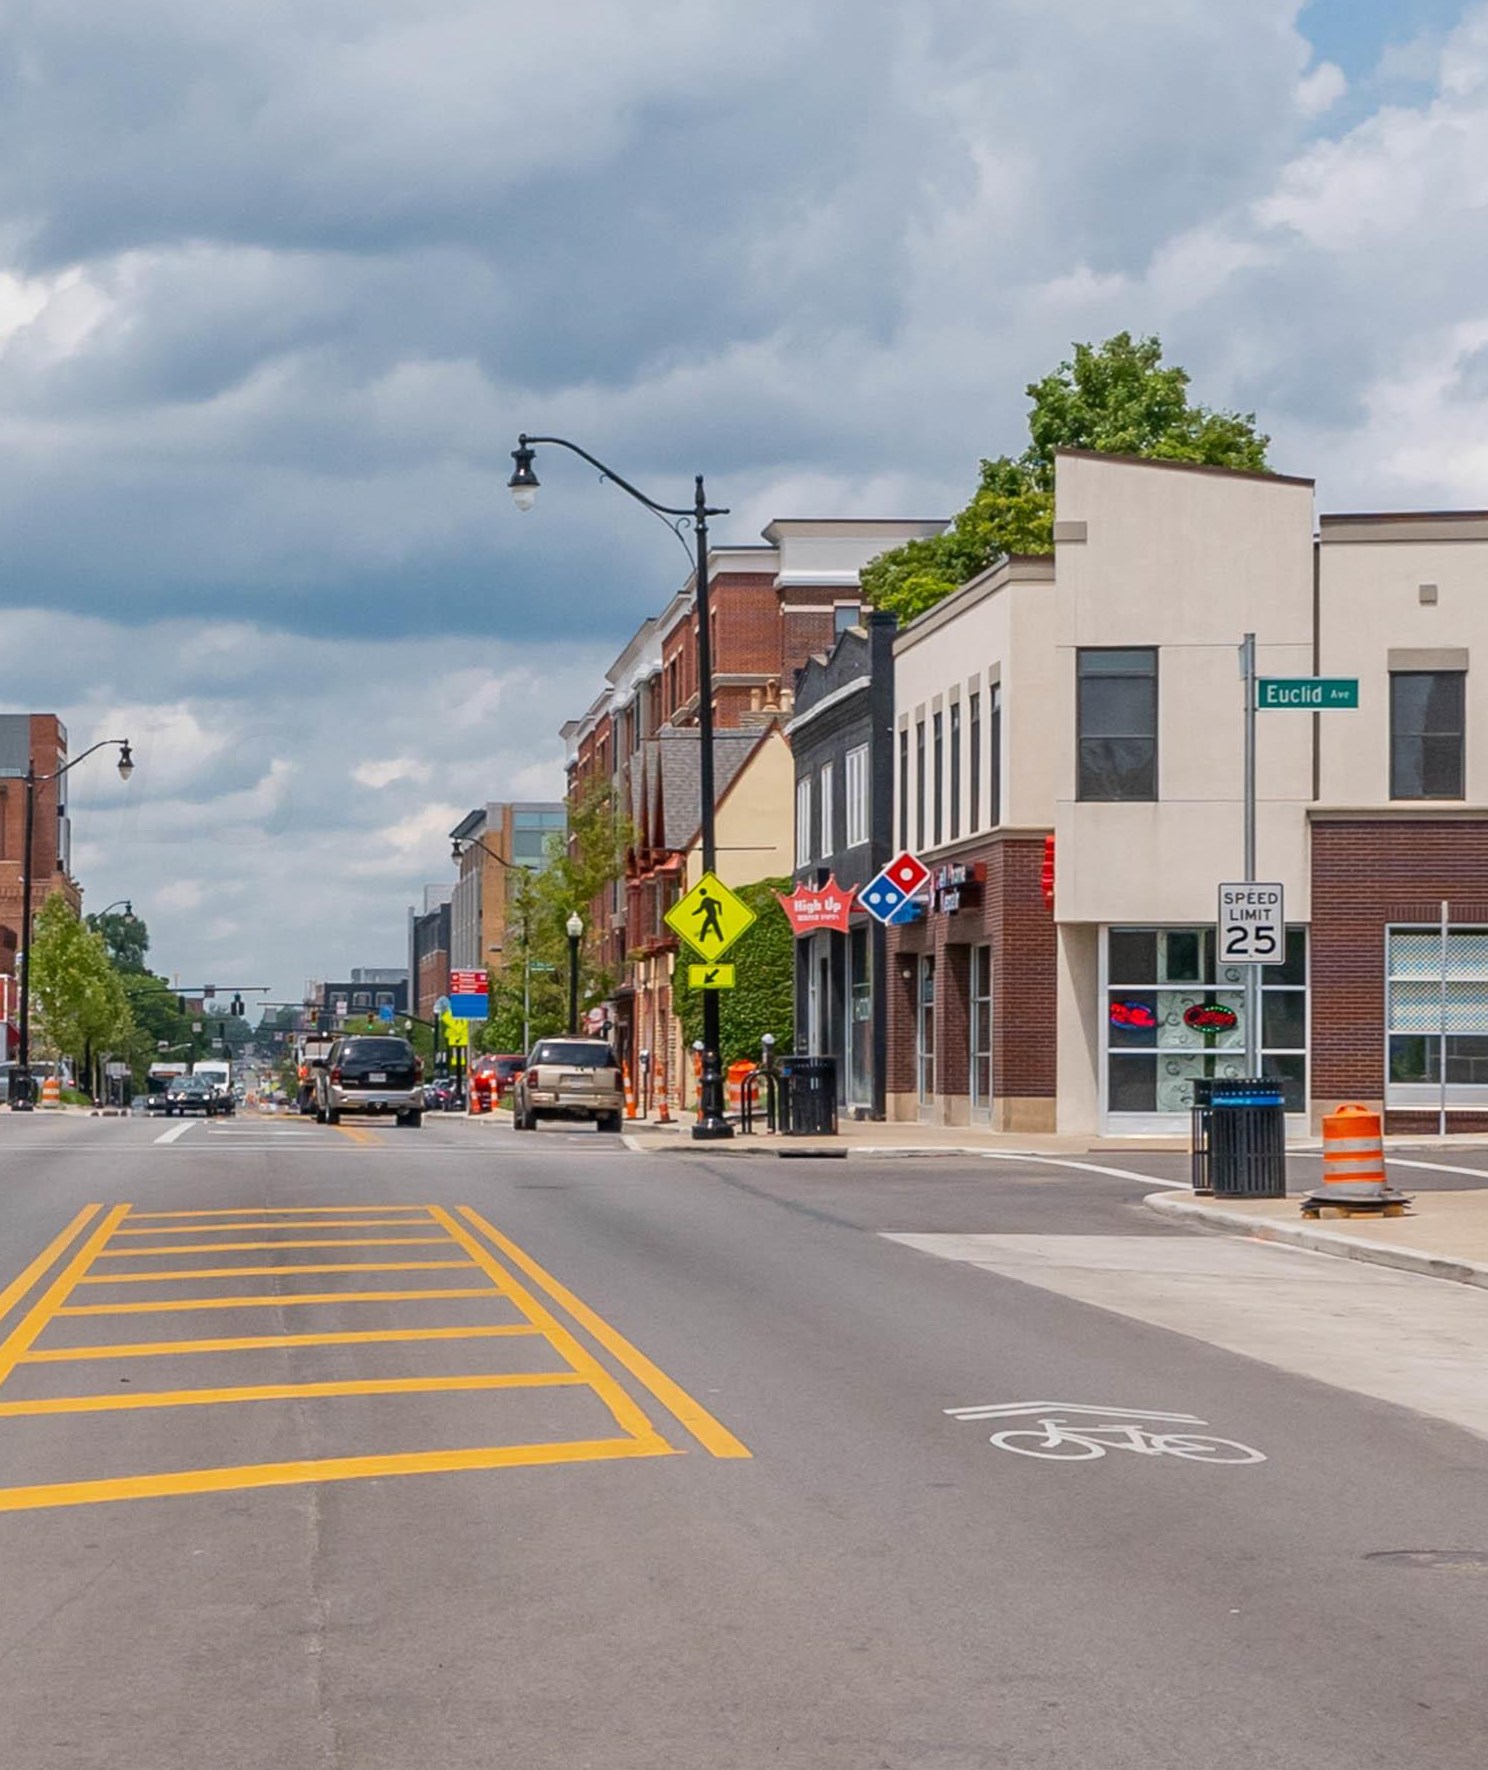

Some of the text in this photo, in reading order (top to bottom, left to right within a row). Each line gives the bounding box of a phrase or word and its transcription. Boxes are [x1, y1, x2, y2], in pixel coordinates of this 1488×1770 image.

[1266, 684, 1350, 703] Euclid Ave
[793, 896, 842, 914] High Up
[1224, 892, 1279, 905] SPEED
[1229, 909, 1272, 921] LIMIT
[1225, 925, 1277, 954] 25
